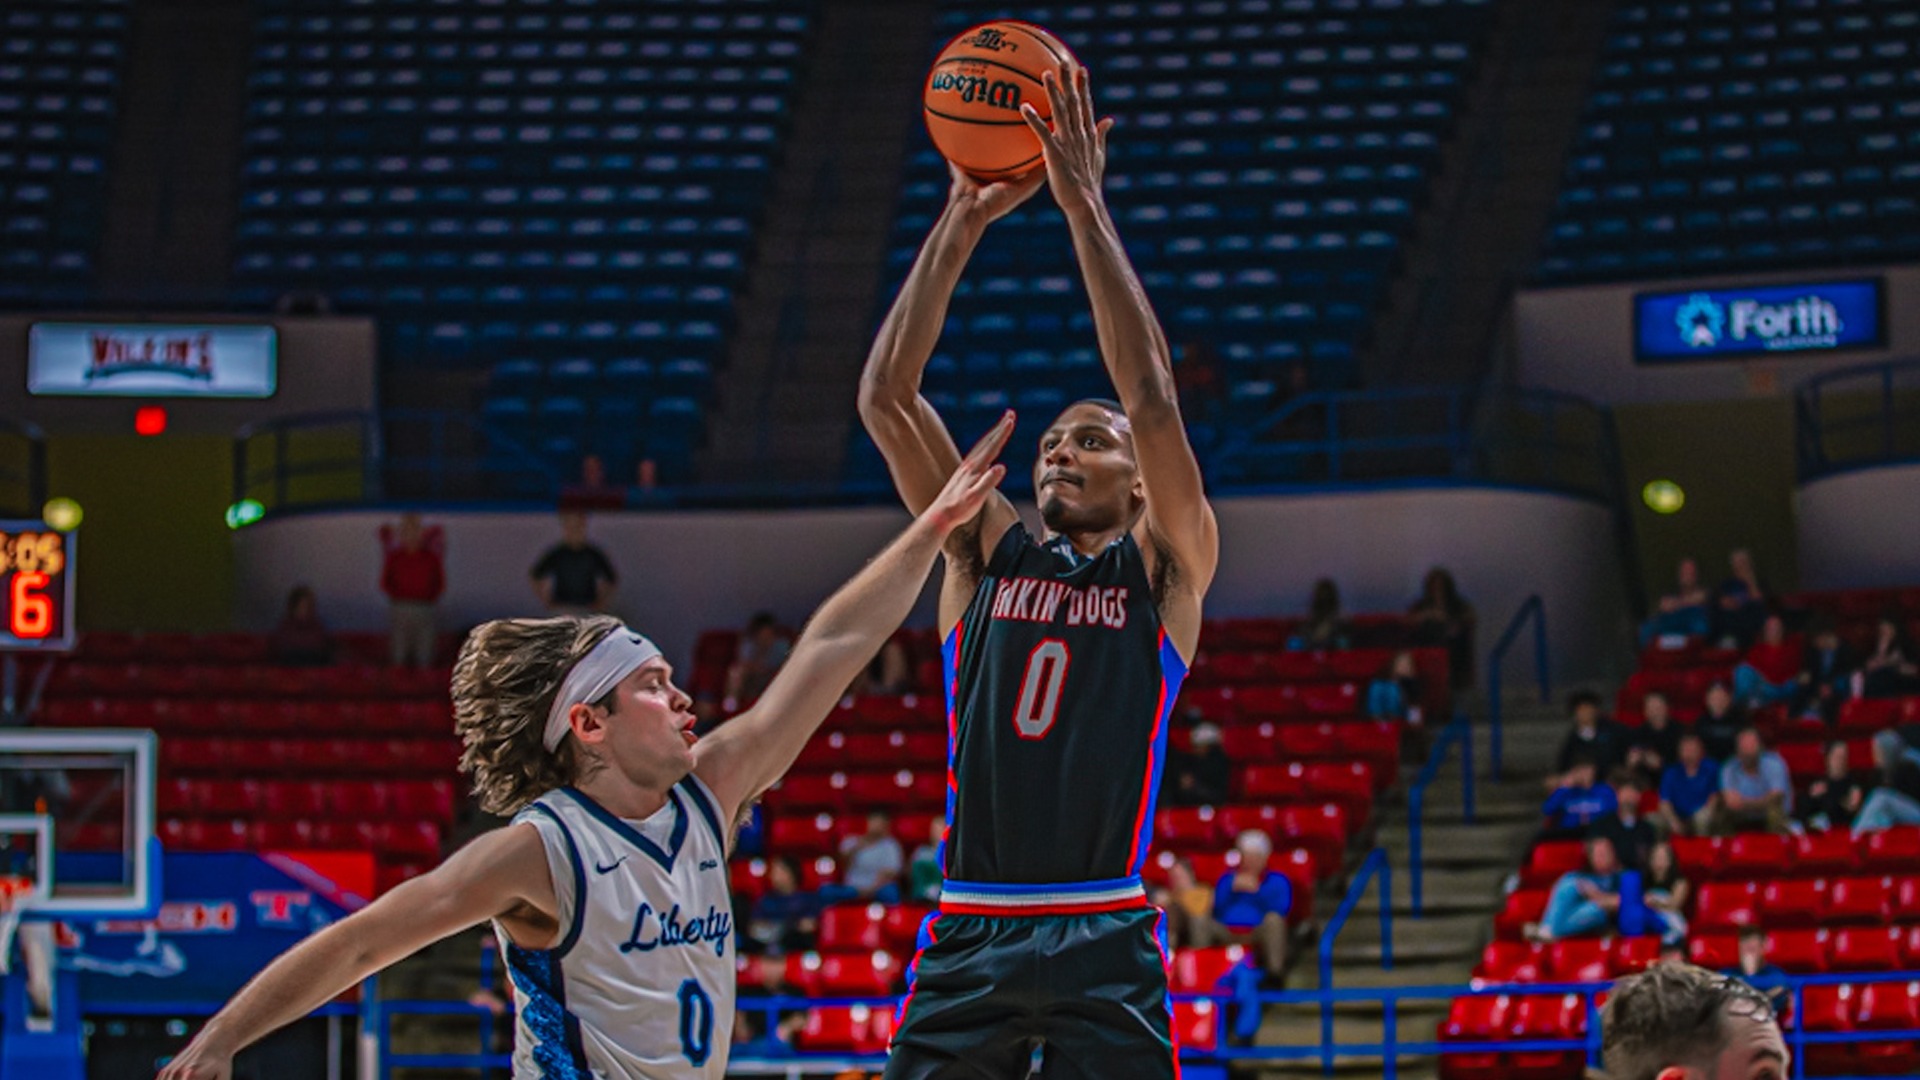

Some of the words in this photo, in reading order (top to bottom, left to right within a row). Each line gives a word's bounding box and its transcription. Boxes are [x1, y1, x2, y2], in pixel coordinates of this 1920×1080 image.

[932, 73, 1021, 111] Wilson
[1730, 296, 1839, 341] Forth
[10, 569, 53, 639] 6
[1011, 637, 1072, 741] 0
[619, 902, 731, 957] Liberty
[676, 978, 714, 1068] 0
